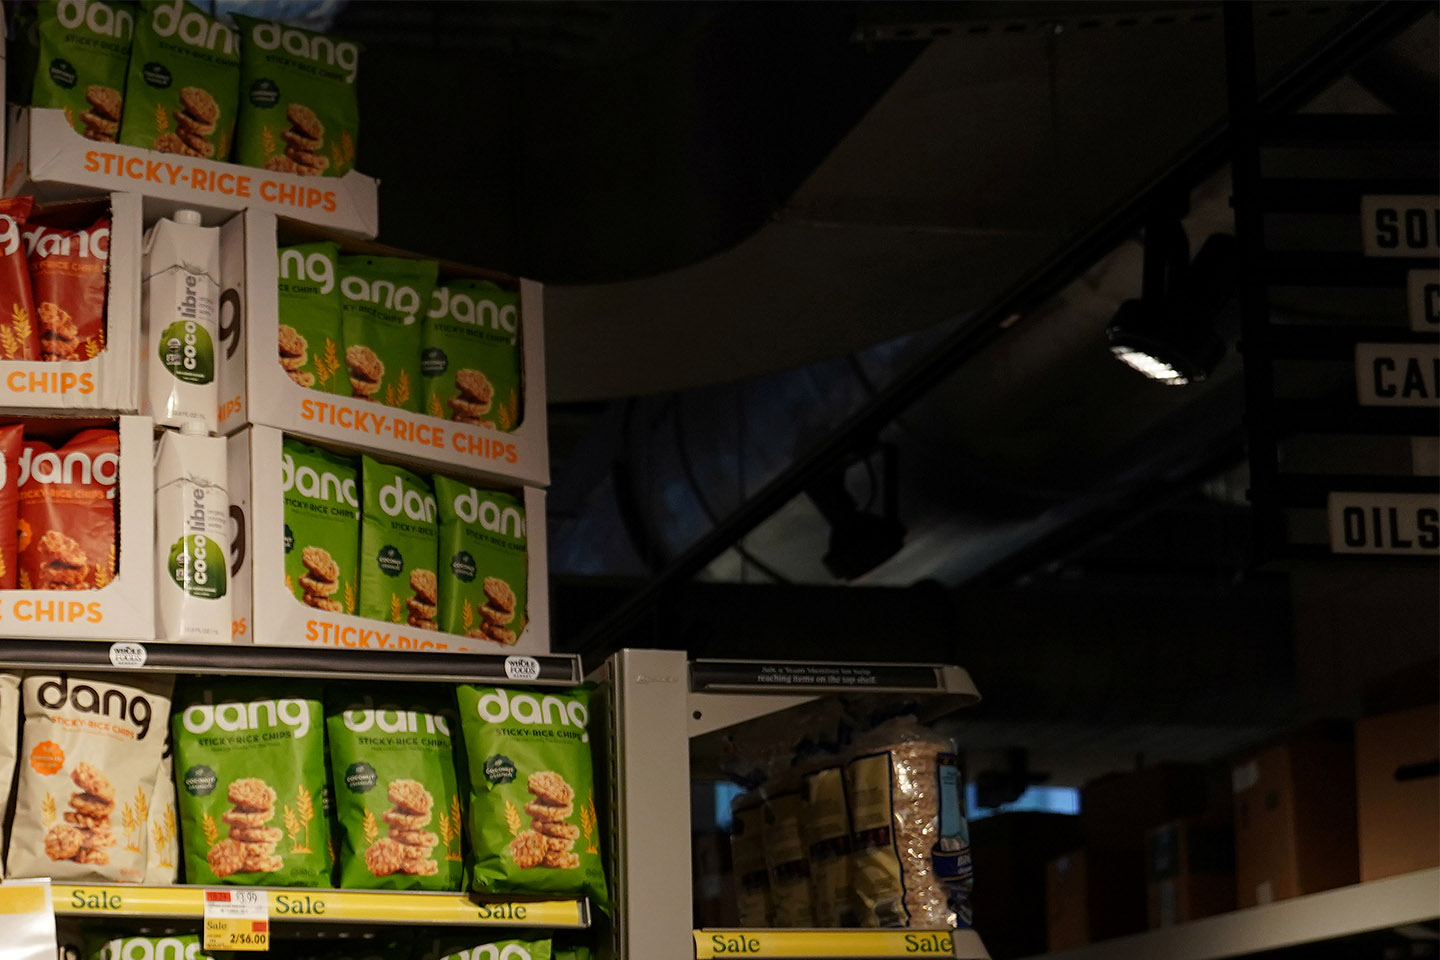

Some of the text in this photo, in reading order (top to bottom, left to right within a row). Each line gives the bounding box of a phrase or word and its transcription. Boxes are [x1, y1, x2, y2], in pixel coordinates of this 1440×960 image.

[252, 21, 359, 84] dang
[84, 150, 337, 213] STICKY-RICE CHIPS
[1376, 208, 1440, 249] SO
[340, 278, 420, 326] ang
[176, 275, 198, 371] libre coco
[8, 370, 95, 394] CHIPS
[1373, 358, 1440, 398] CA
[302, 399, 518, 464] STICKY-RICE CHIPS
[189, 488, 206, 586] libre coco
[1343, 507, 1440, 548] OILS
[14, 599, 103, 623] CHIPS
[509, 666, 536, 674] FOODS
[37, 672, 152, 740] dang
[183, 693, 310, 739] dang
[478, 688, 588, 742] dang
[71, 889, 122, 910] Sale
[275, 893, 326, 914] Sale
[477, 900, 527, 920] Sale
[207, 920, 228, 931] Sale
[230, 933, 267, 945] 2/$6.00
[712, 934, 761, 954] Sale
[906, 934, 952, 954] Sale
